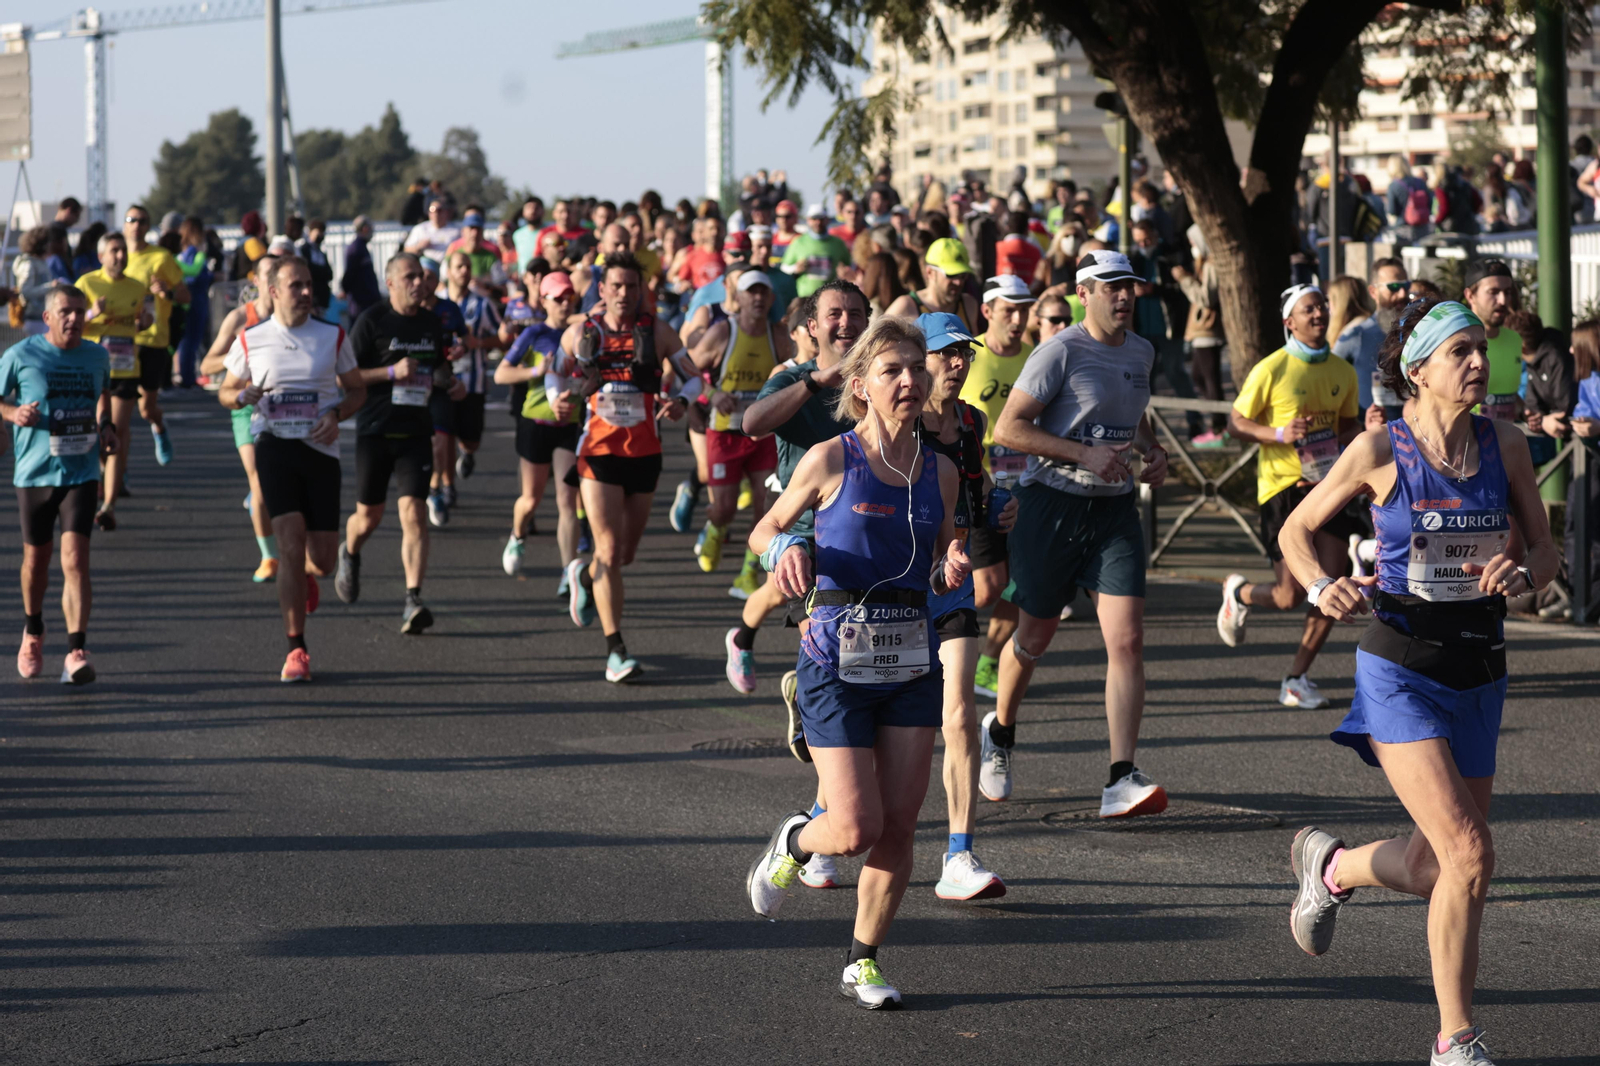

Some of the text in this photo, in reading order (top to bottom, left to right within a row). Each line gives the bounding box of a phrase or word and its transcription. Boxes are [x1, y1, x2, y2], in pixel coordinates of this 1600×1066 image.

[66, 410, 91, 418] ZURICH
[1308, 430, 1334, 442] ZURICH
[858, 502, 897, 515] SCAB
[1419, 499, 1463, 509] SCAB
[1446, 515, 1500, 528] ZURICH
[1445, 544, 1478, 558] 9072
[871, 607, 919, 619] ZURICH
[872, 633, 902, 647] 9115
[873, 654, 899, 664] FRED
